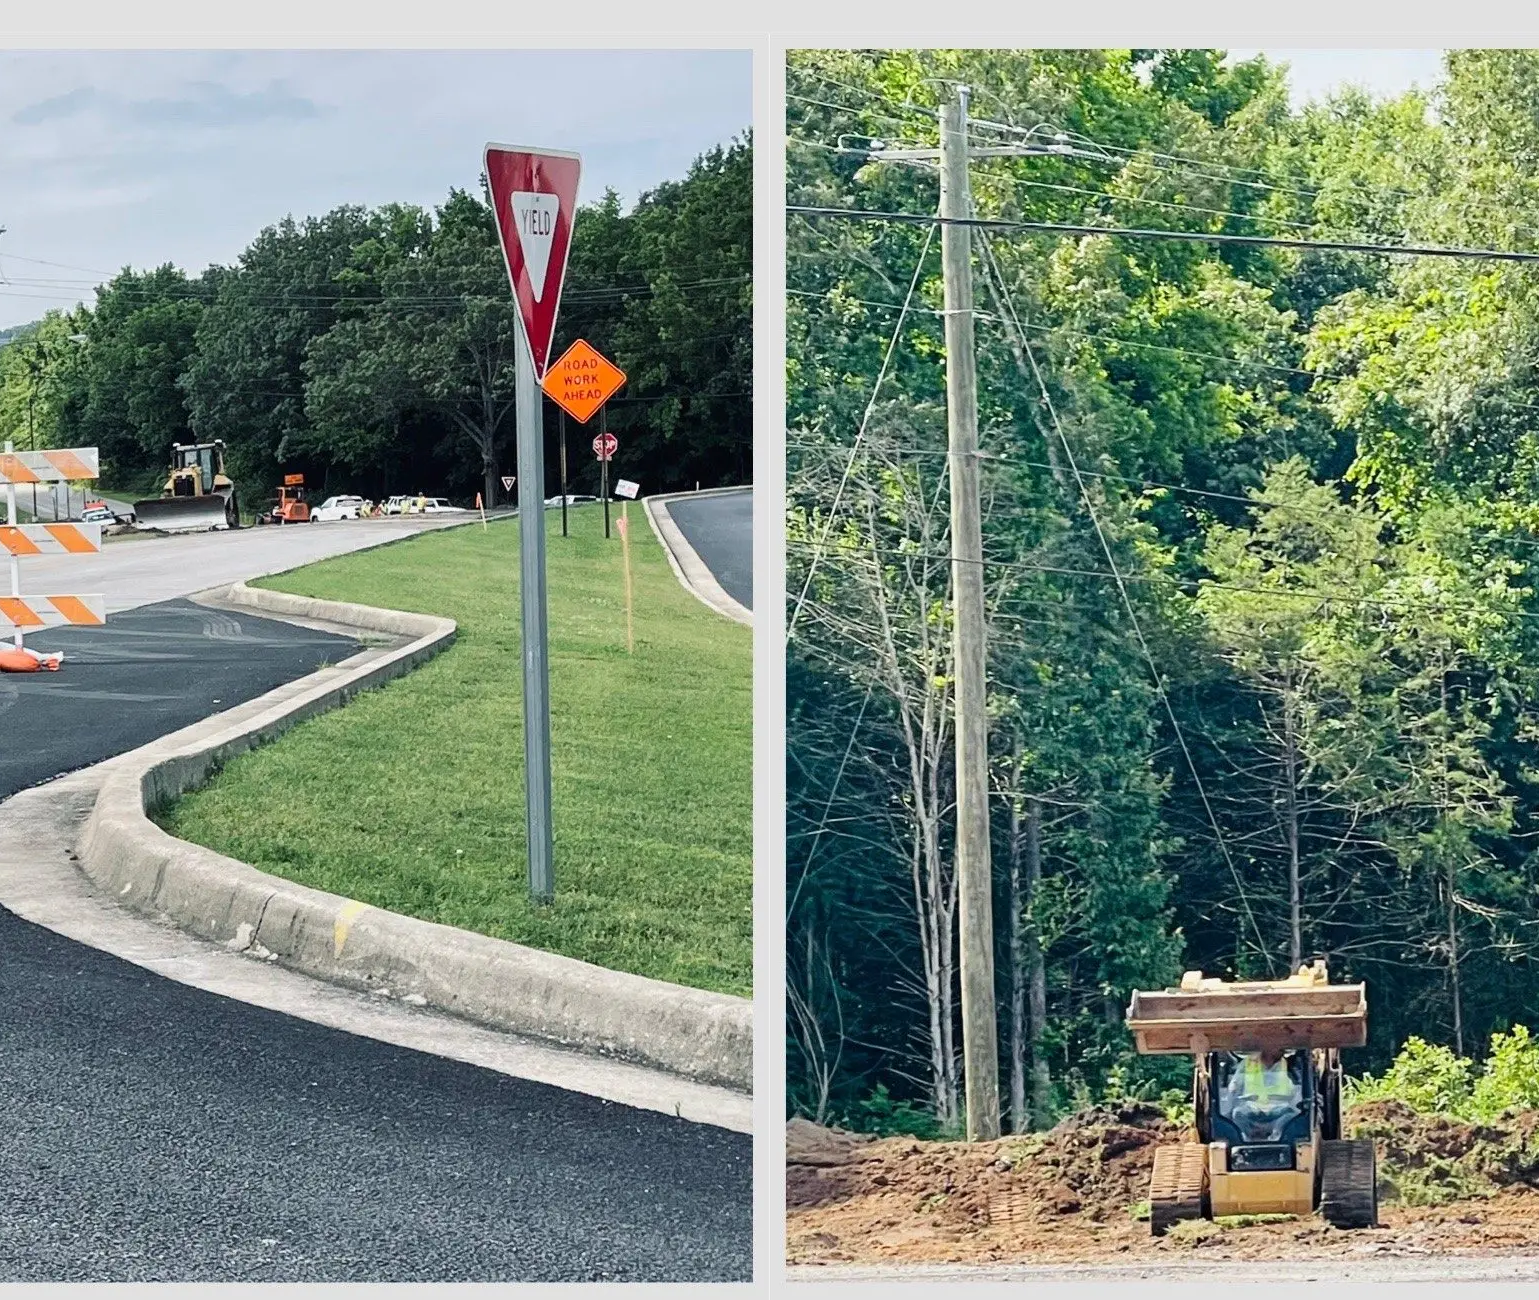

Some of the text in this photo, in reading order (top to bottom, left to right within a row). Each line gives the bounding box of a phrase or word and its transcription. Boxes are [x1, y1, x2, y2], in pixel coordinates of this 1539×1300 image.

[521, 209, 551, 236] YIELD
[563, 358, 598, 371] ROAD
[563, 374, 599, 386] WORK
[563, 389, 602, 401] AHEAD
